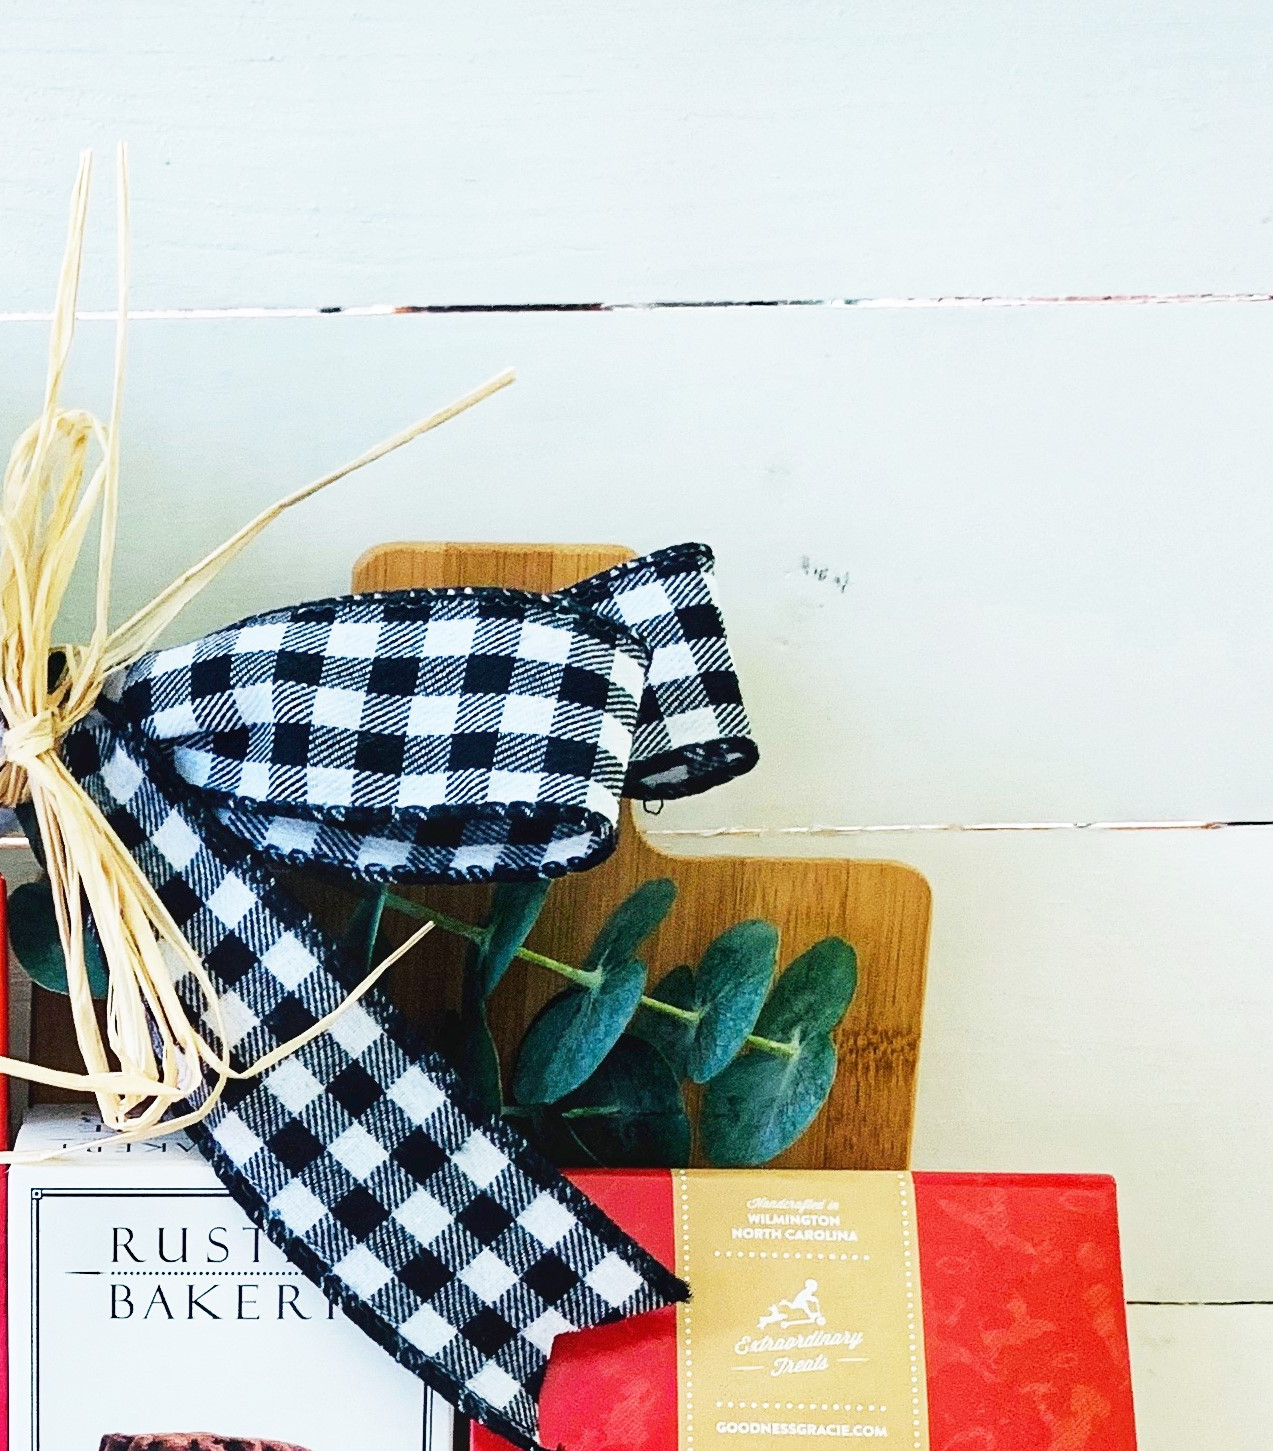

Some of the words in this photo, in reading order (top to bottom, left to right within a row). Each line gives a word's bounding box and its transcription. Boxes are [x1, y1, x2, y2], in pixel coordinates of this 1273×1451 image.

[747, 1197, 825, 1213] Handcrafted
[828, 1201, 839, 1209] in
[748, 1214, 840, 1226] WILMINGTON
[732, 1228, 781, 1240] NORTH
[785, 1229, 858, 1242] CAROLINA
[111, 1226, 263, 1264] RUST
[734, 1331, 863, 1355] Extraordinary
[770, 1355, 828, 1377] Treats
[716, 1422, 887, 1436] GOODNESSGRACIE.COM
